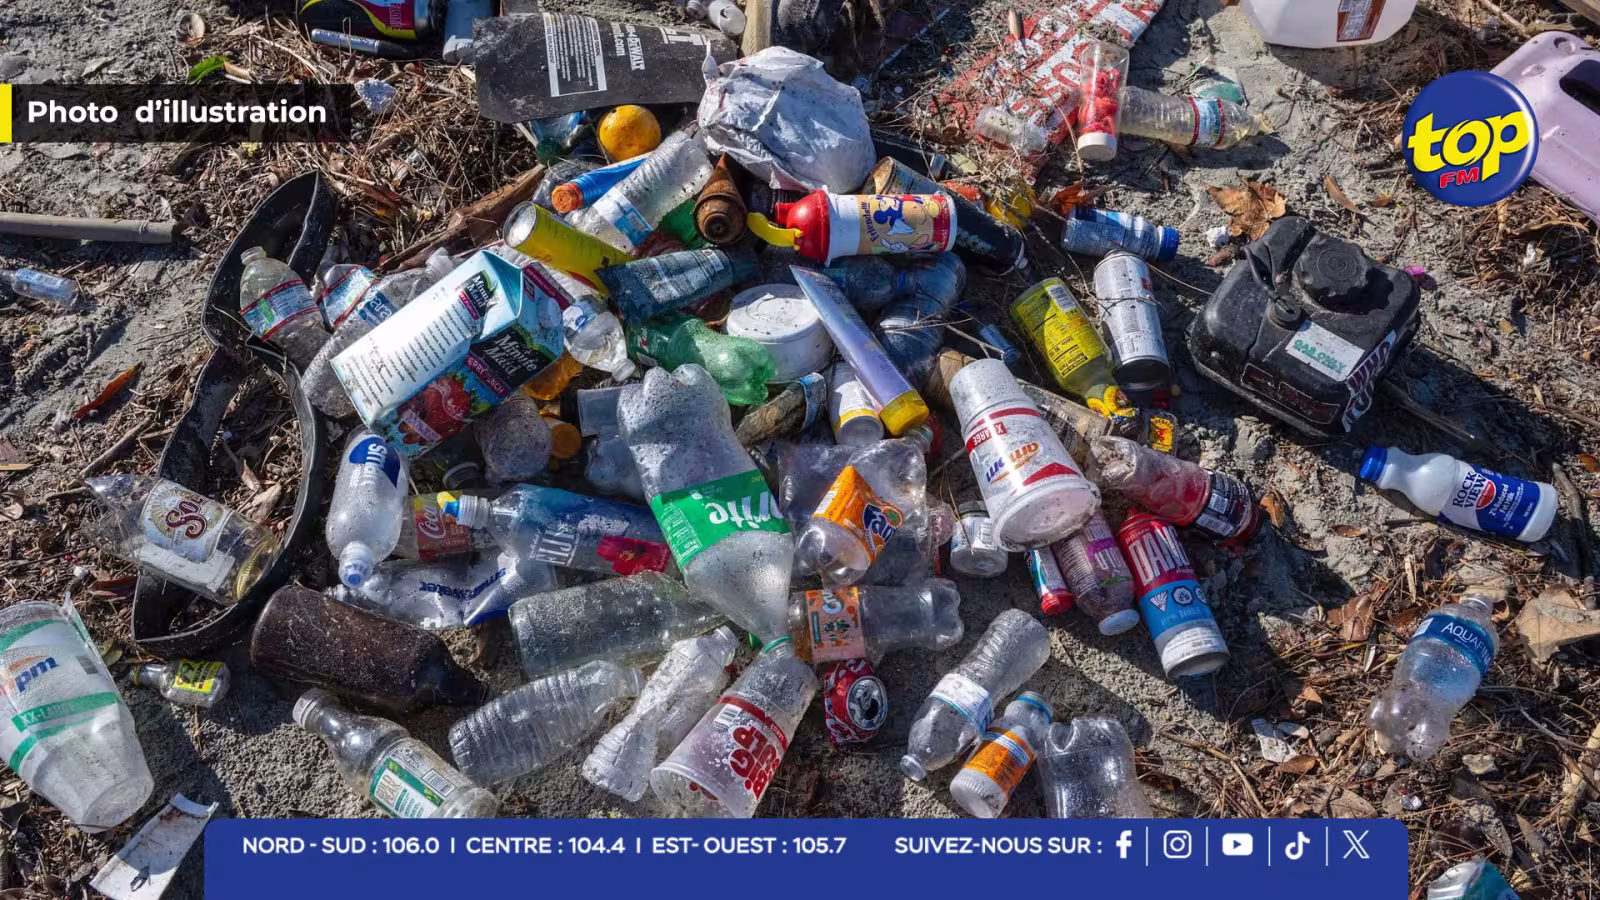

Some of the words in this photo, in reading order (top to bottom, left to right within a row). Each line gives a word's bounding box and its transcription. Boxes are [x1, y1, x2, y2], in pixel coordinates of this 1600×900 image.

[467, 282, 486, 308] Maid
[482, 340, 522, 378] Maid
[494, 330, 538, 373] Minute
[466, 356, 487, 375] ERRY
[1452, 471, 1476, 507] ROCK
[1463, 474, 1487, 508] VIEW
[1493, 483, 1508, 507] Reduced
[1504, 491, 1515, 504] Milk
[705, 491, 783, 529] rite
[375, 773, 392, 798] GOLD
[382, 780, 400, 805] PEAK
